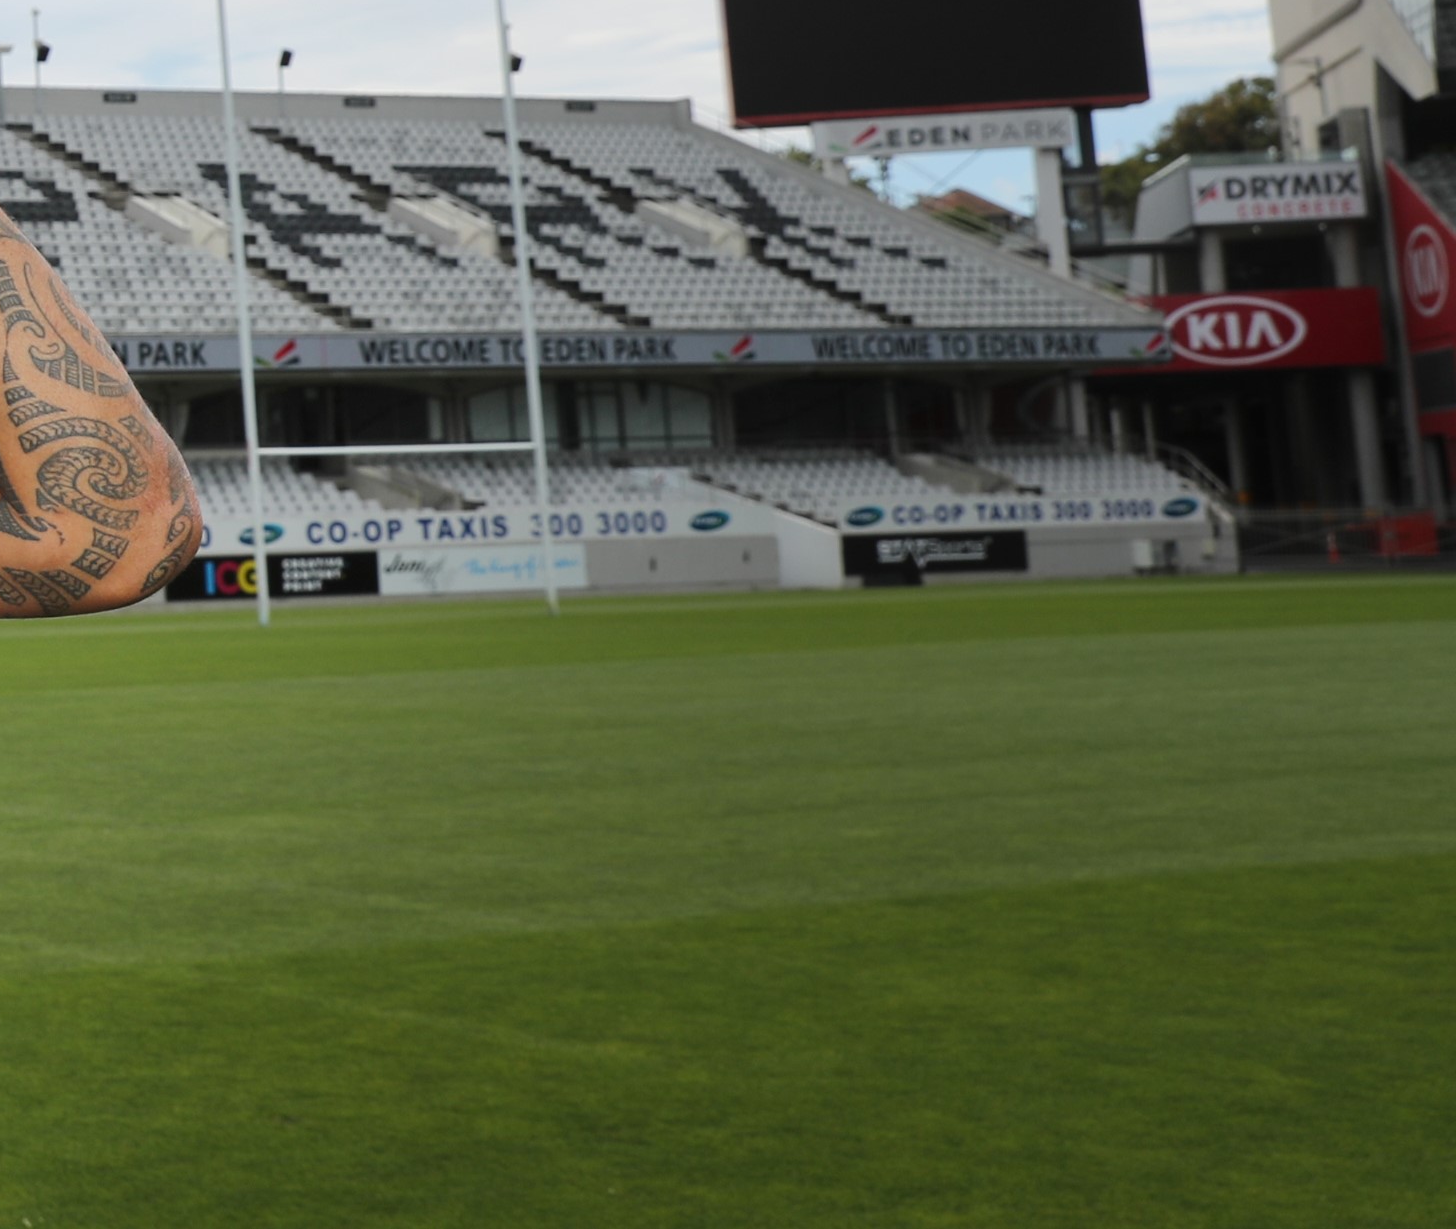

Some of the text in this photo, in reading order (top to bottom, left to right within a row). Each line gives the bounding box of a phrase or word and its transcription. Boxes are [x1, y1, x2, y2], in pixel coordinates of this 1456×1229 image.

[886, 119, 1068, 149] EDEN PARK
[1225, 172, 1359, 201] DRYMIX
[1237, 199, 1355, 219] CONCRETE
[1186, 310, 1285, 351] KIA
[138, 341, 207, 368] PARK
[359, 339, 491, 365] WELCOME
[540, 338, 607, 363] EDEN
[614, 336, 678, 361] PARK
[811, 332, 1102, 361] WELCOME TO EDEN PARK
[891, 504, 966, 524] CO-OP
[975, 501, 1045, 522] TAXIS
[1051, 501, 1092, 521] 300
[1101, 499, 1155, 519] 3000
[306, 519, 404, 545] CO-OP
[417, 514, 510, 541] TAXIS
[529, 513, 585, 538] 300
[596, 510, 668, 536] 3000
